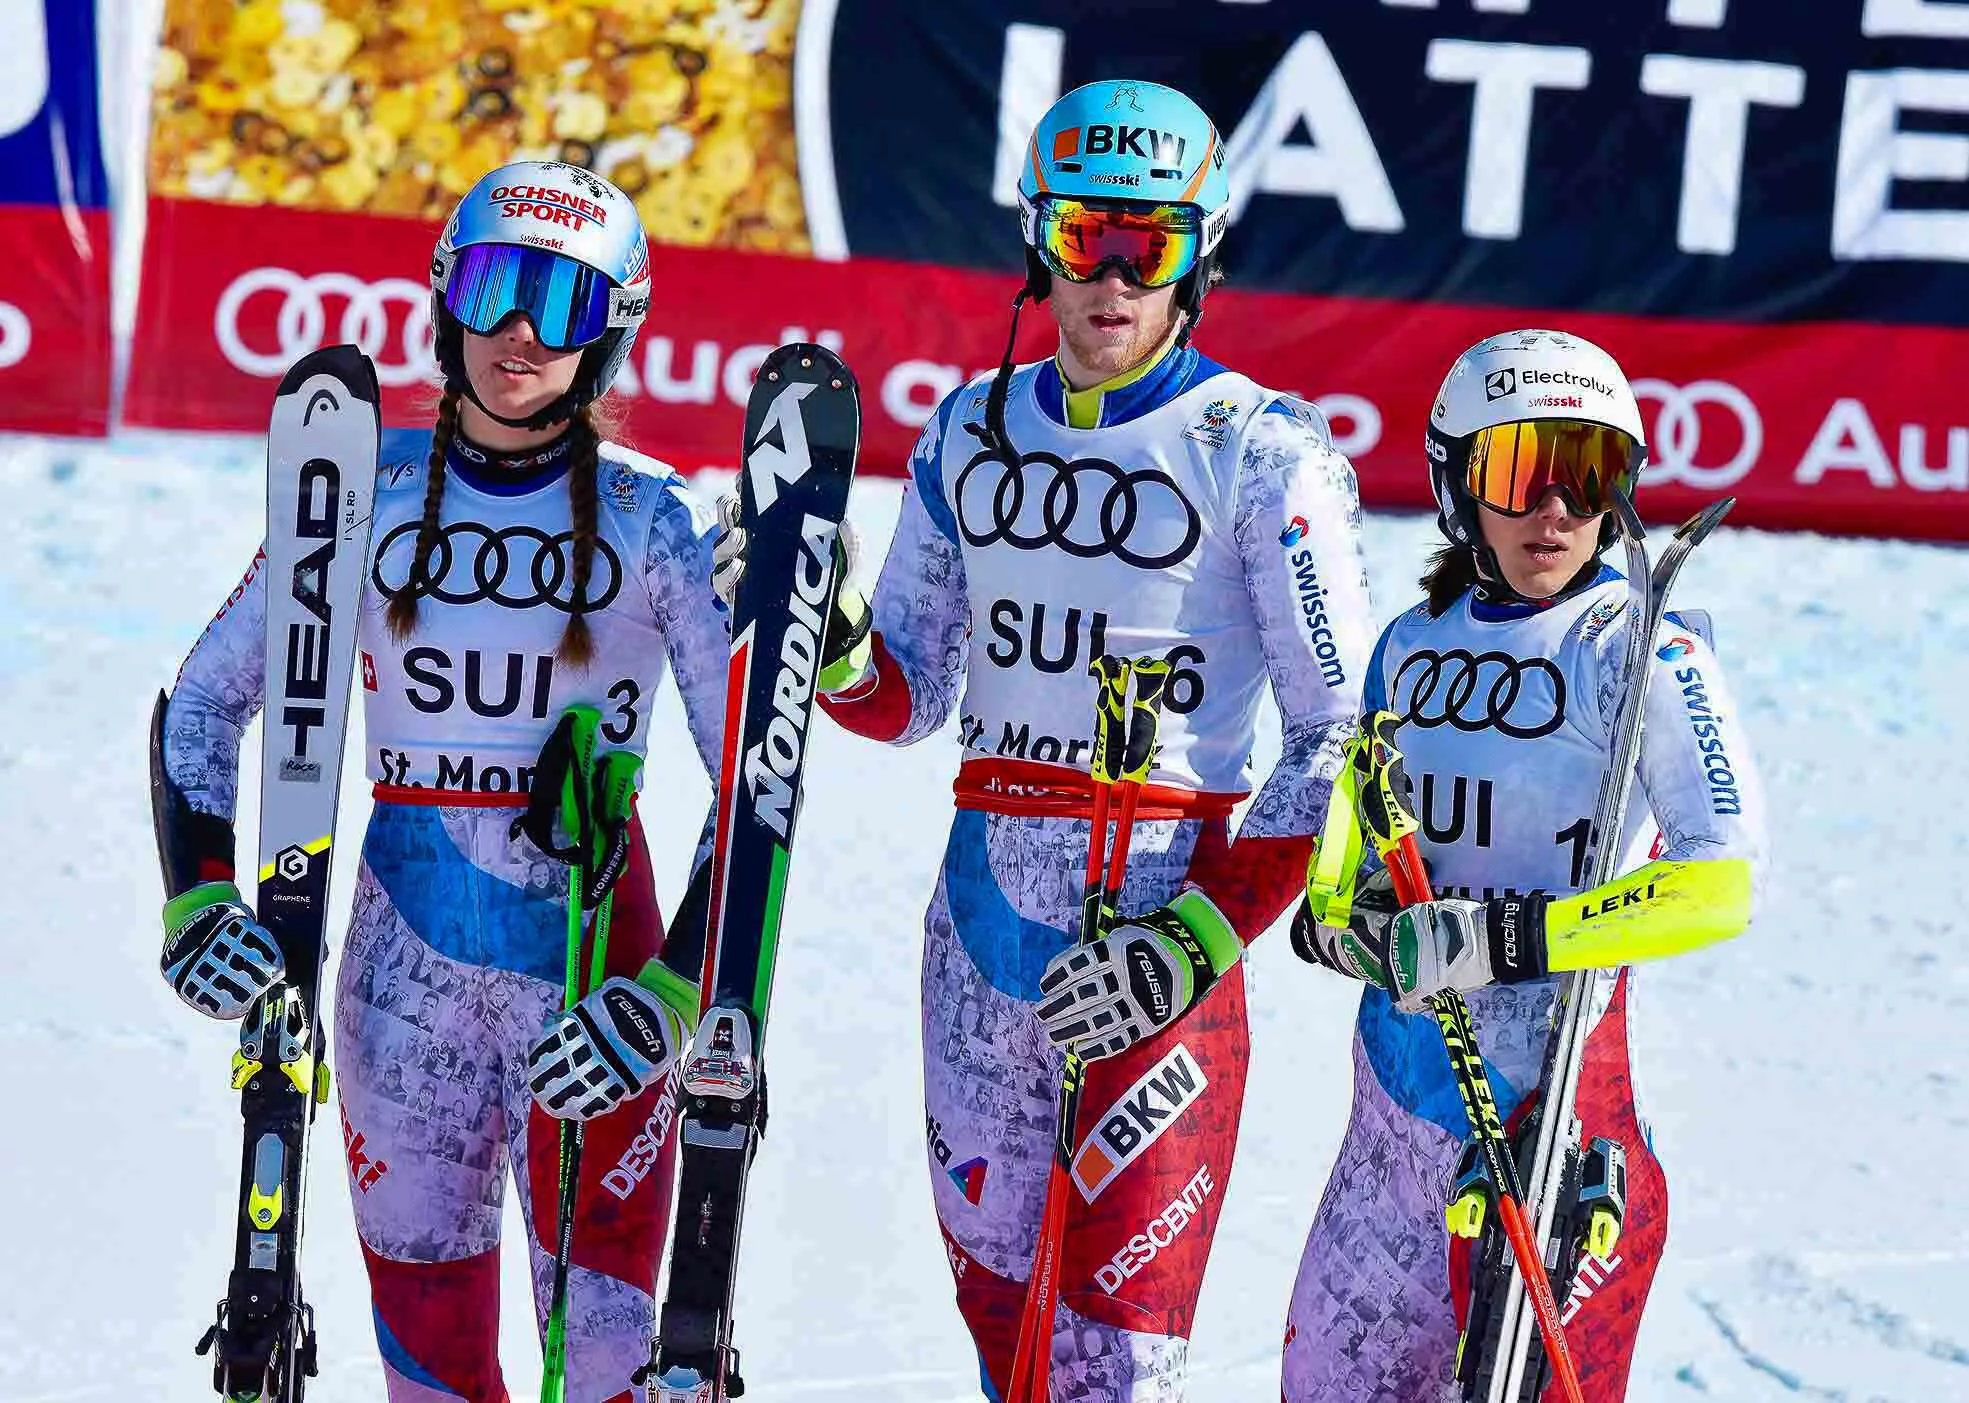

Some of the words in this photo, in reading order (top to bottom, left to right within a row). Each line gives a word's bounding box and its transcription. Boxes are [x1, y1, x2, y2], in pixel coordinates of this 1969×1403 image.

[1085, 124, 1186, 167] BKW
[490, 185, 608, 224] OCHSNER
[1088, 173, 1140, 187] swissski
[501, 202, 588, 233] SPORT
[519, 233, 566, 250] swissski
[1522, 370, 1616, 398] Electrolux
[1528, 395, 1583, 408] swissski
[1425, 434, 1447, 463] EAD
[281, 457, 341, 758] HEAD
[986, 598, 1107, 676] SUI
[1291, 549, 1346, 689] swisscom
[402, 646, 554, 720] SUI
[744, 513, 839, 839] NORDICA
[1161, 645, 1206, 714] 6
[601, 678, 640, 745] 3
[1675, 667, 1741, 815] swisscom
[435, 754, 540, 793] Mor
[1382, 790, 1405, 828] LEKI
[1402, 772, 1493, 848] UI
[1556, 819, 1592, 888] 1
[272, 894, 311, 902] GRAPHENE
[1582, 884, 1656, 921] LEKI
[1167, 920, 1208, 966] LEKI
[1503, 902, 1520, 967] racing
[1134, 951, 1169, 1016] reusch
[611, 994, 661, 1052] reusch
[1099, 1054, 1197, 1159] BKW
[1094, 1163, 1216, 1297] DESCENTE
